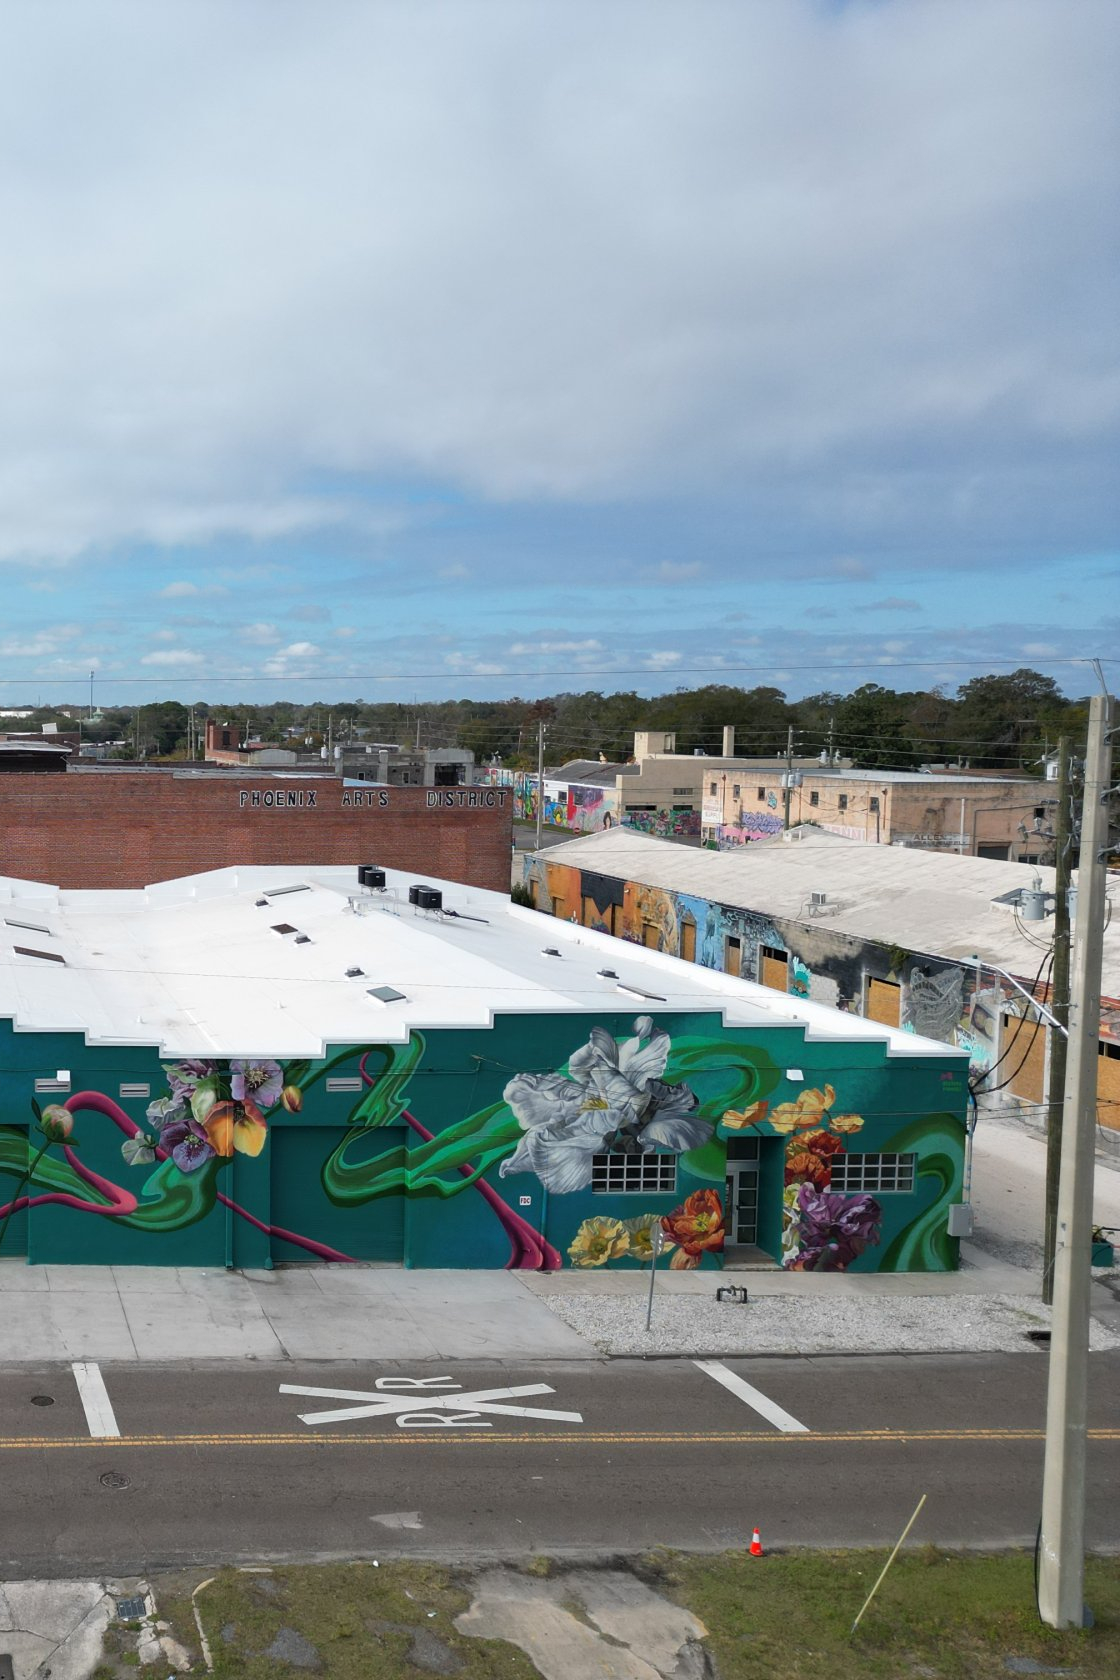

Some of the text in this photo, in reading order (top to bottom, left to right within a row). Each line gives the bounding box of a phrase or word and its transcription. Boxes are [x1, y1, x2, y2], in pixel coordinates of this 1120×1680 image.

[240, 790, 507, 807] PHOENIX ARTS DISTRICT
[374, 1375, 463, 1389] R
[396, 1412, 493, 1428] R
